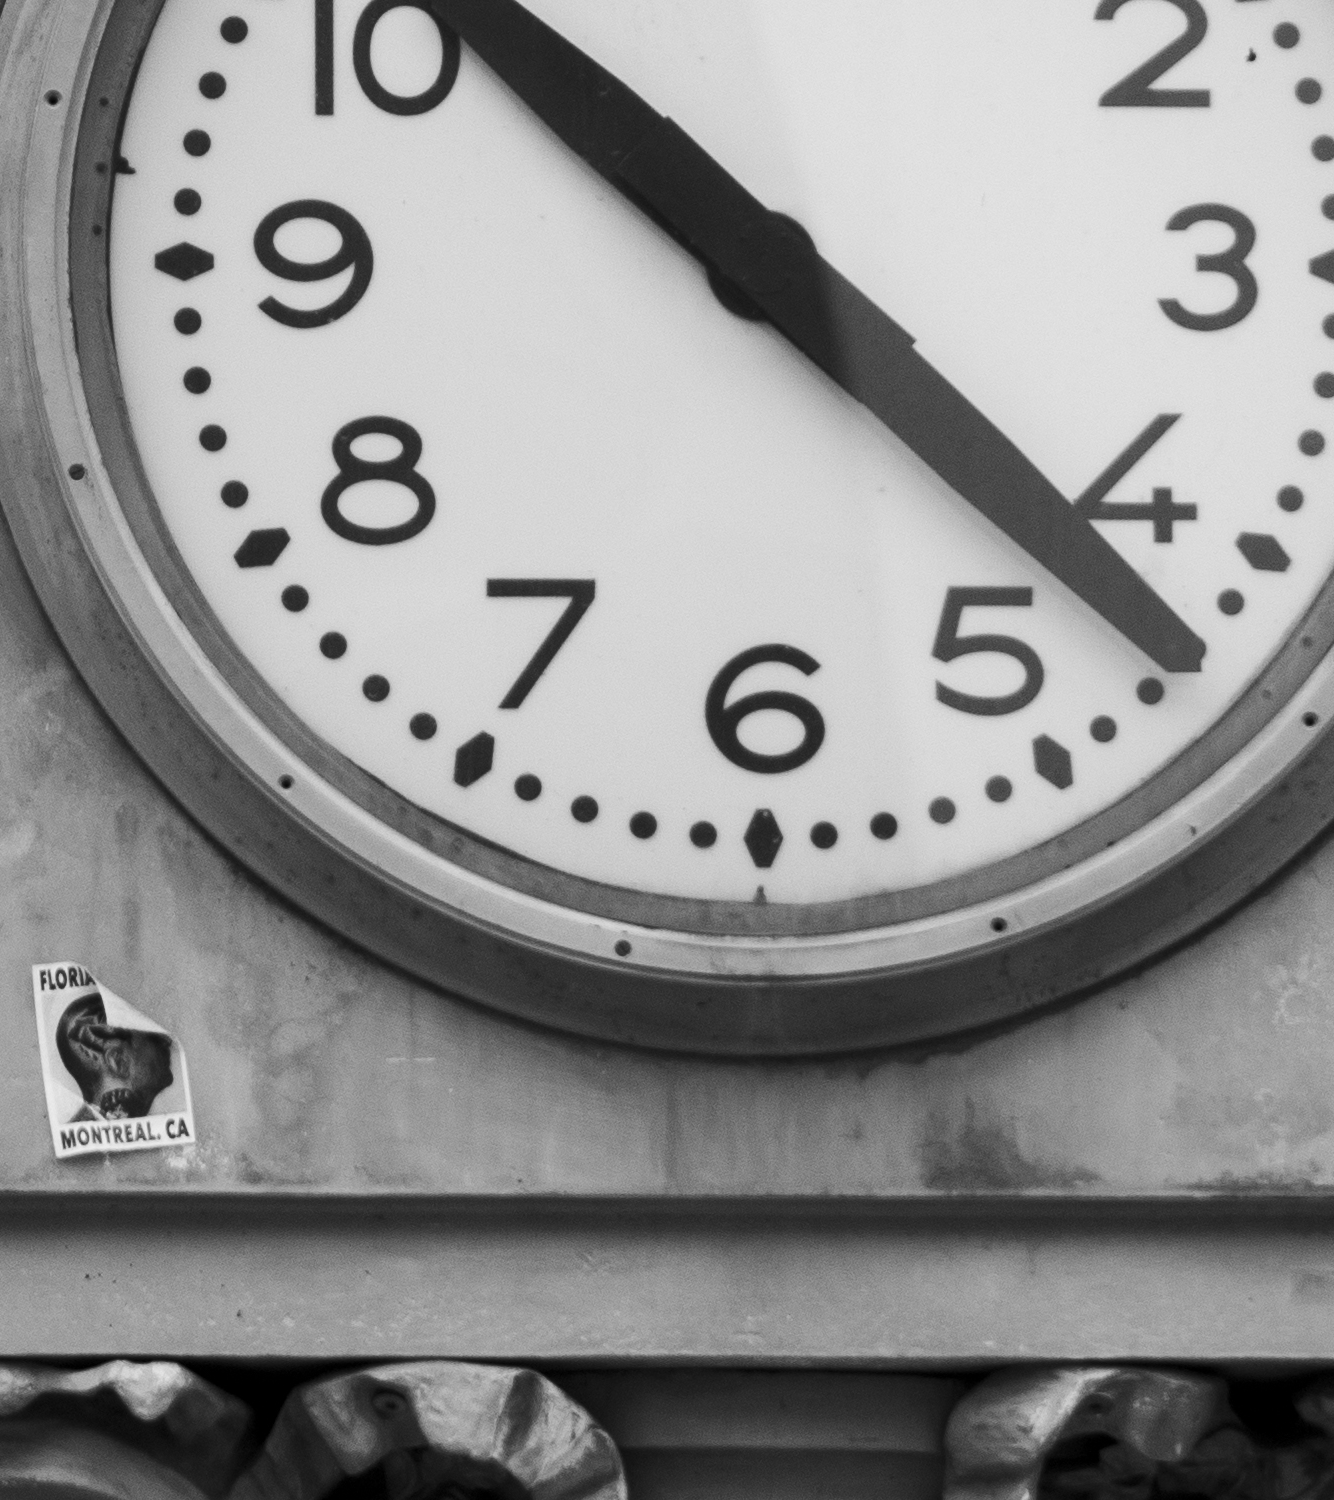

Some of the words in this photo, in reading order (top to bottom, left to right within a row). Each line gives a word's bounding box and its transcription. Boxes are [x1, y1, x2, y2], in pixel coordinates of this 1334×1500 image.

[252, 199, 375, 329] 9
[1157, 203, 1259, 331] 3
[320, 415, 436, 546] 8
[1073, 413, 1198, 544] 4
[485, 578, 597, 710] 7
[704, 643, 825, 775] 6
[930, 586, 1045, 717] 5
[165, 1117, 190, 1140] CA
